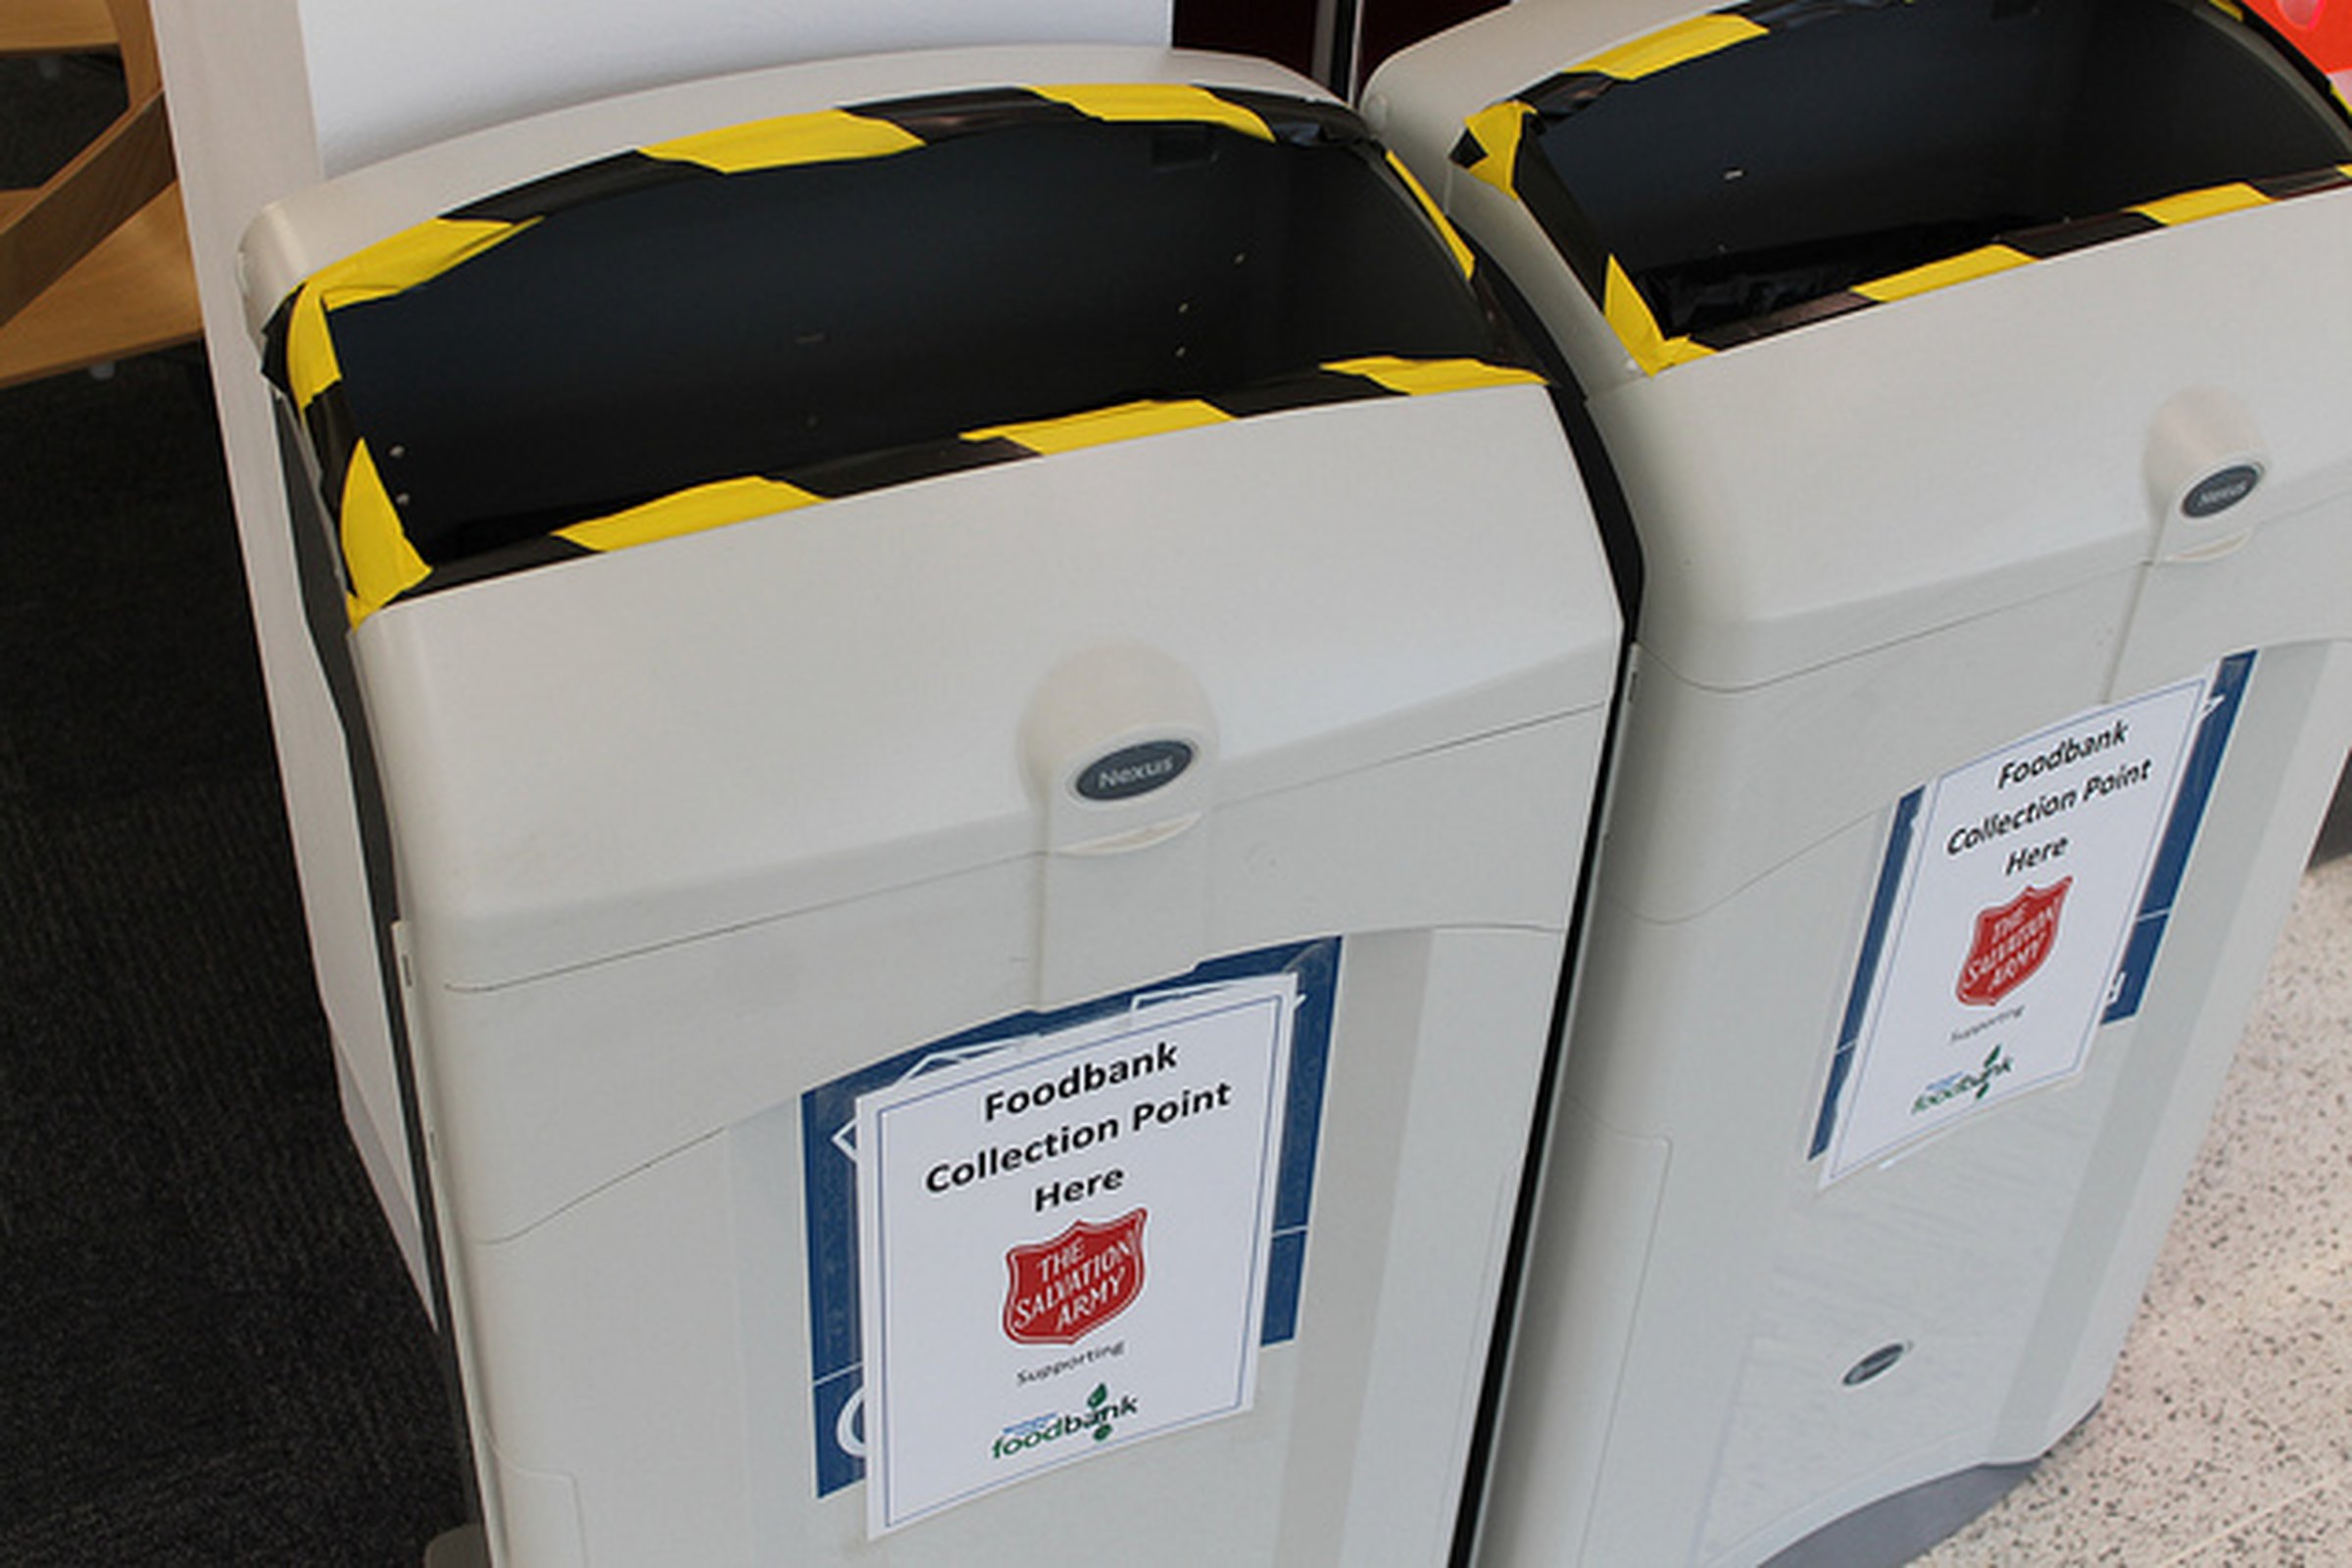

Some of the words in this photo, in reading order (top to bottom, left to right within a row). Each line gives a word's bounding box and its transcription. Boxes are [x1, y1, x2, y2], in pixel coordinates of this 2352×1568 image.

[1097, 755, 1174, 789] Nexus
[1996, 719, 2131, 790] Foodbank
[1946, 789, 2078, 857] Collection
[2081, 758, 2153, 805] Point
[2004, 835, 2069, 876] Here
[983, 1041, 1179, 1122] Foodbank
[924, 1116, 1119, 1194] Collection
[1131, 1080, 1232, 1134] Point
[1033, 1166, 1125, 1213] Here
[1013, 1230, 1136, 1330] SALVATION
[1037, 1237, 1086, 1283] THE
[1054, 1265, 1125, 1333] ARMY
[1016, 1340, 1125, 1386] Supporting
[992, 1395, 1138, 1459] foodbank
